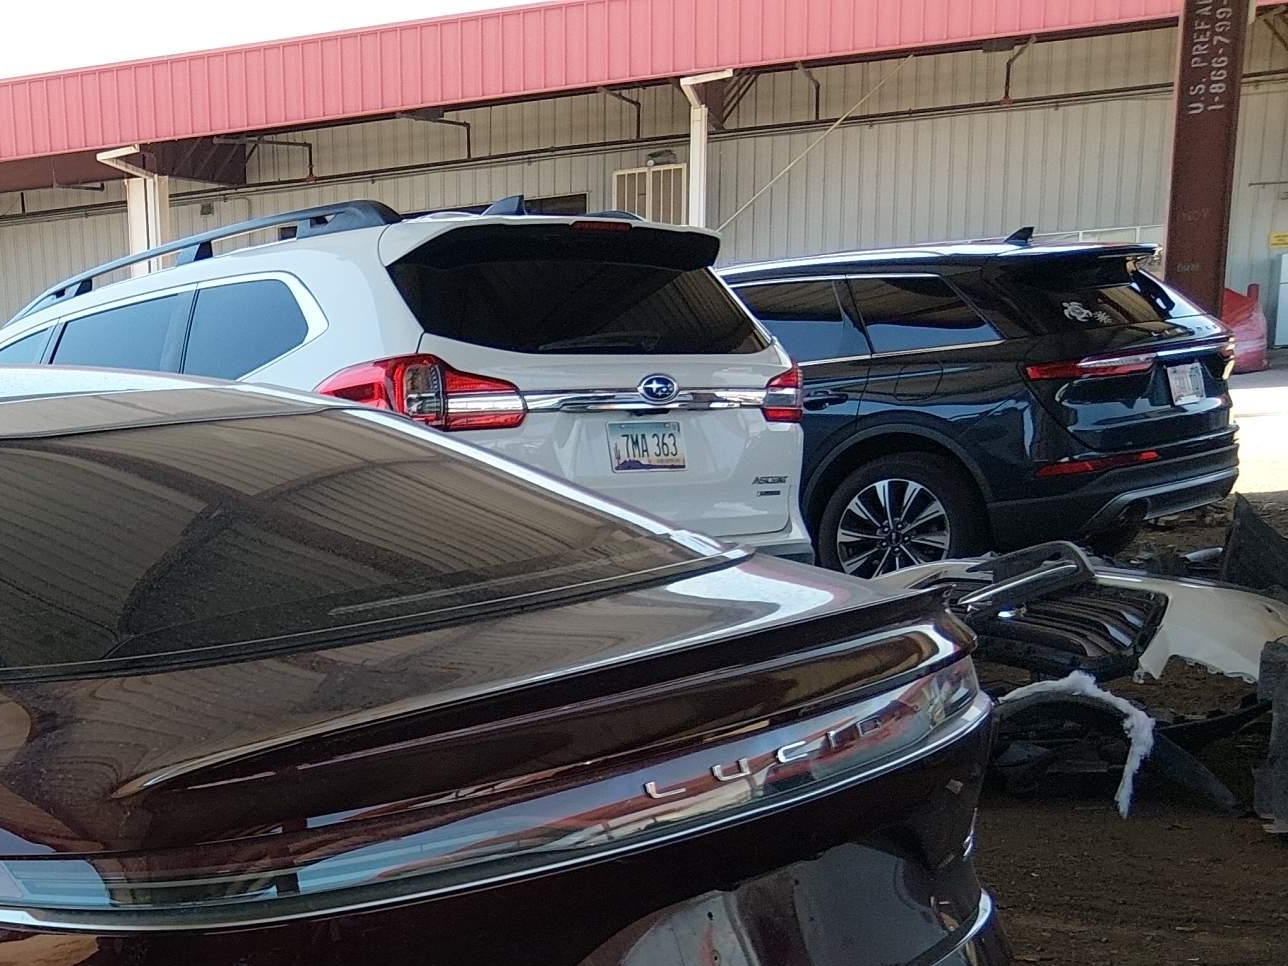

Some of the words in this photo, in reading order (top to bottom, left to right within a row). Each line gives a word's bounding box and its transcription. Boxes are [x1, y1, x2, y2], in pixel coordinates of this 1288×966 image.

[1187, 78, 1208, 115] U.S.
[621, 433, 650, 458] 7MA
[652, 433, 678, 457] 363
[644, 718, 882, 799] LUCID
